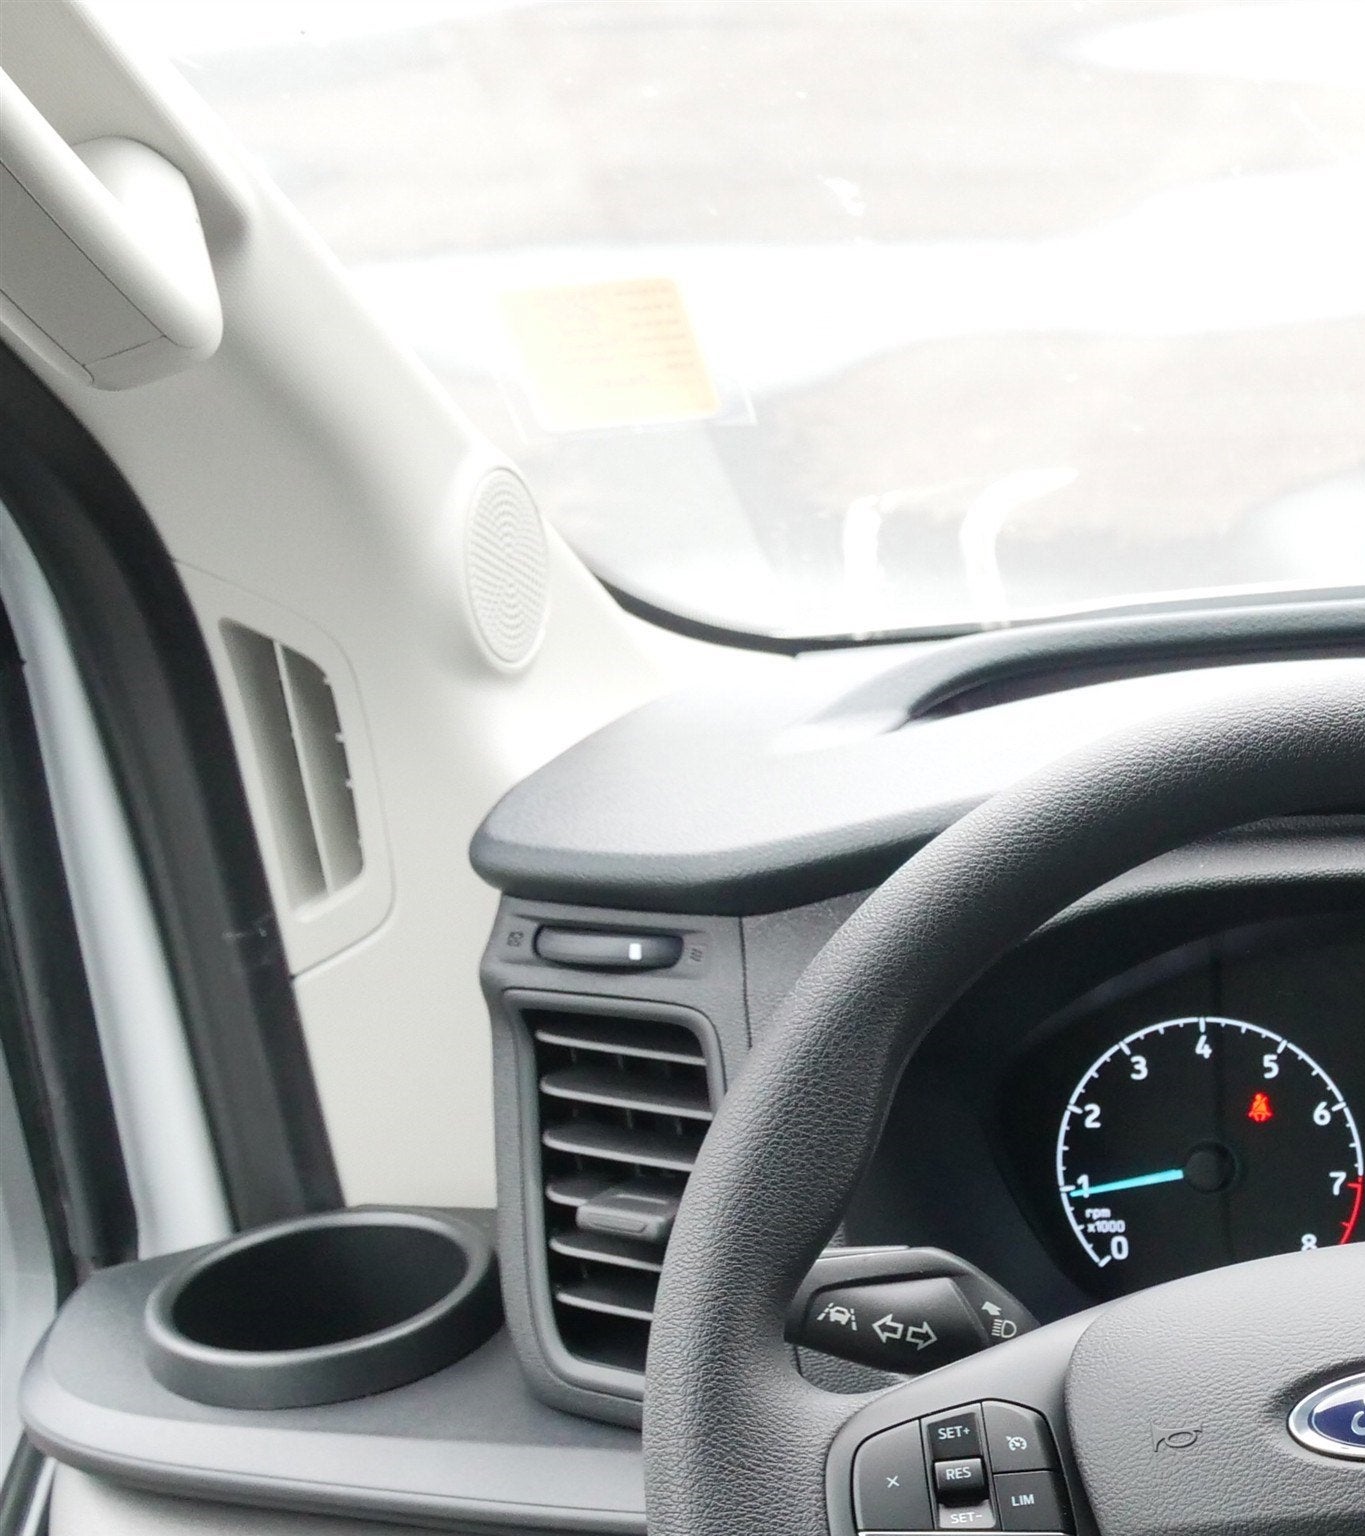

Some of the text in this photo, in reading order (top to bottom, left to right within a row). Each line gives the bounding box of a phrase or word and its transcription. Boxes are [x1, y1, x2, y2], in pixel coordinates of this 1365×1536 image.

[1195, 1035, 1212, 1058] 4
[1130, 1055, 1149, 1080] 3
[1263, 1055, 1280, 1079] 5
[1084, 1103, 1102, 1129] 2
[1313, 1101, 1332, 1126] 6
[1076, 1174, 1090, 1198] 1
[1329, 1171, 1347, 1195] 7
[1085, 1207, 1111, 1220] rpm
[1087, 1218, 1126, 1233] x1000
[1110, 1236, 1129, 1260] 0
[1301, 1233, 1318, 1251] 8
[937, 1425, 971, 1441] SET+
[945, 1466, 972, 1481] RES
[1011, 1493, 1035, 1507] LIM
